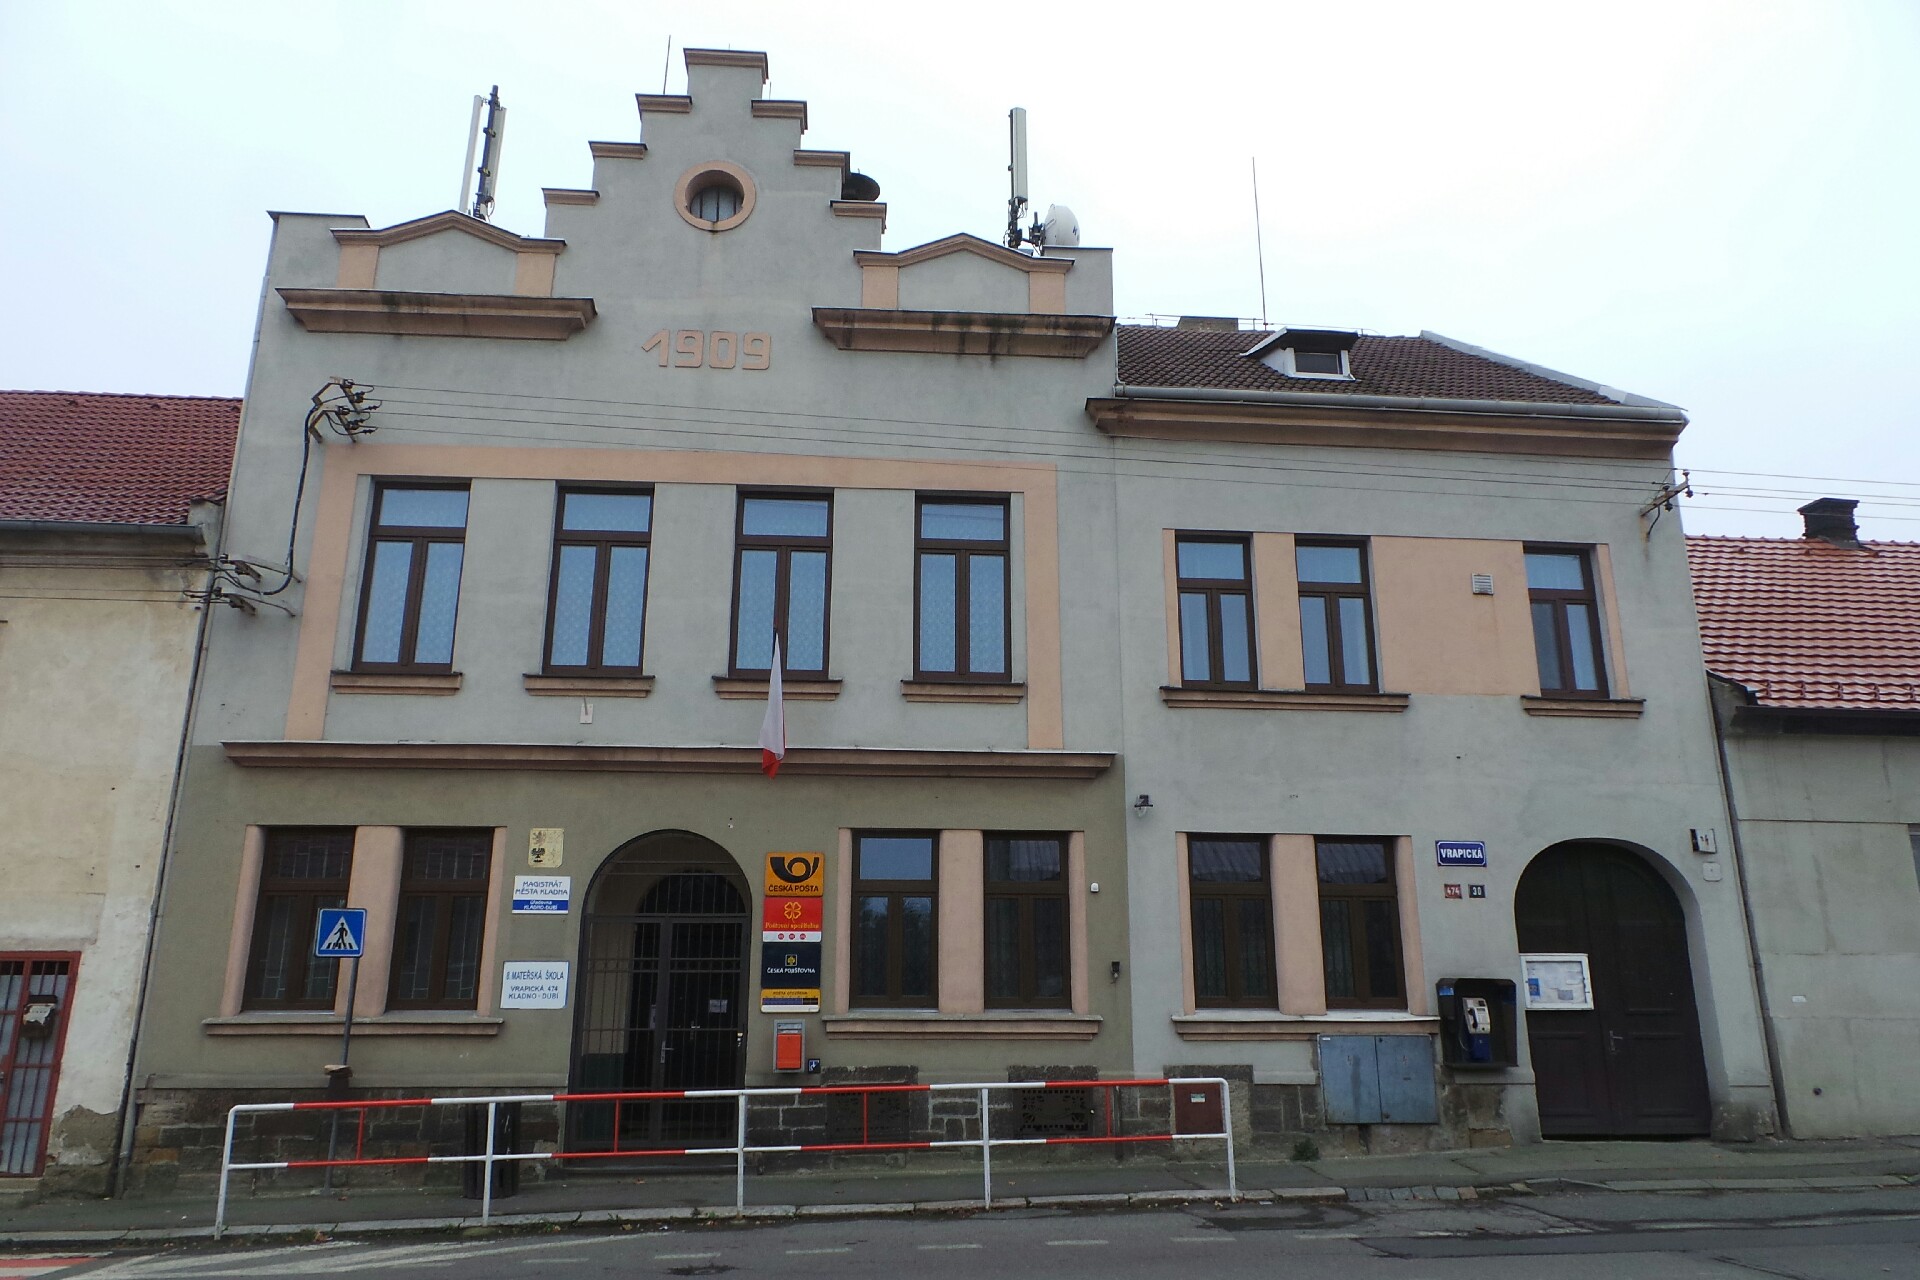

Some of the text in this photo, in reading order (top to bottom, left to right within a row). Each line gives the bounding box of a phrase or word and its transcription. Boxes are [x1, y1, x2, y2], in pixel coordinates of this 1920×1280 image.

[641, 328, 772, 370] 1909
[1440, 847, 1483, 859] VRAPICKÁ
[768, 884, 819, 893] ČESKÁ POŠTA
[1447, 887, 1460, 896] 474
[1472, 886, 1482, 896] 30
[545, 969, 564, 980] ŠKOLA
